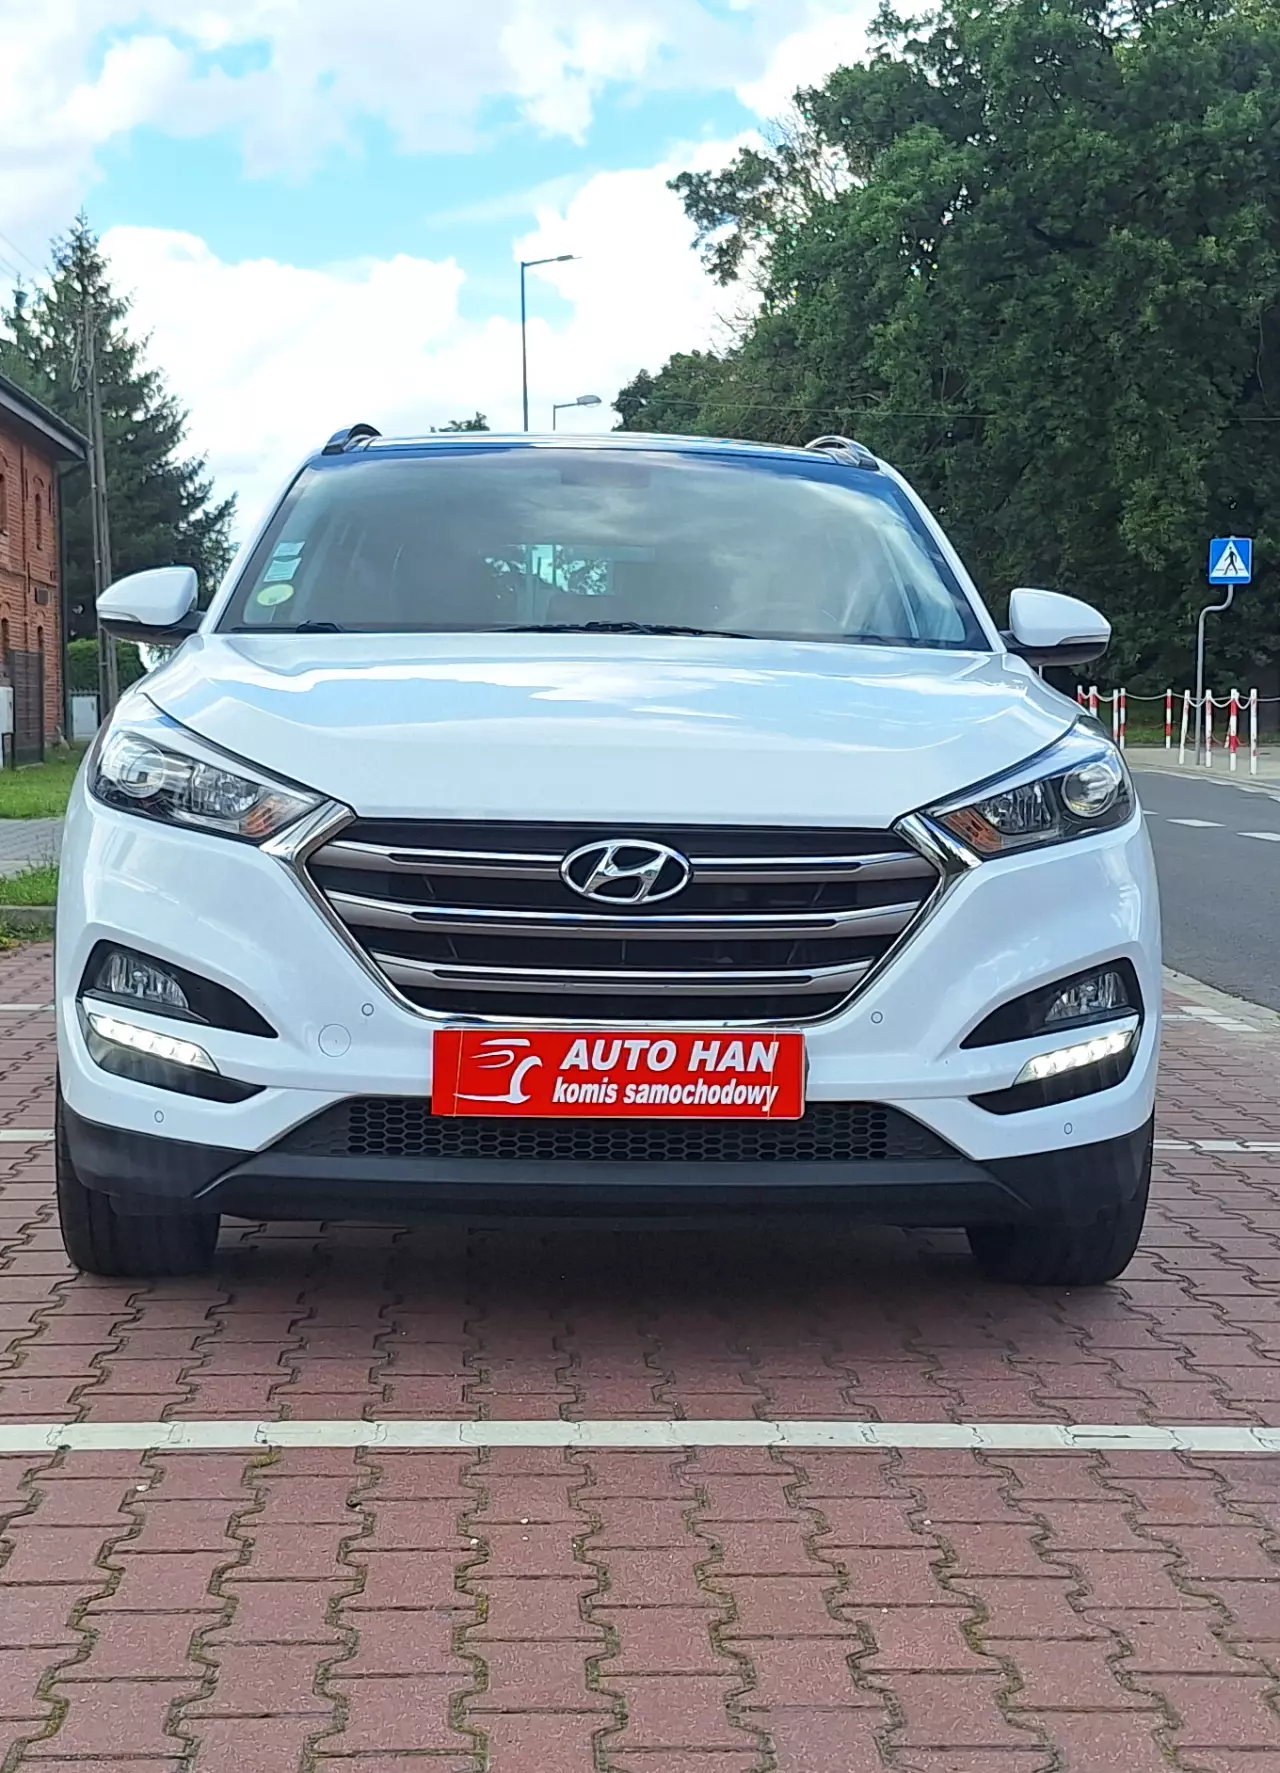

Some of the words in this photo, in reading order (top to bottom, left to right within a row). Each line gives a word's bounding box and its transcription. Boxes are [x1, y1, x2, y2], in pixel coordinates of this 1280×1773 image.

[559, 1039, 677, 1071] AUTO
[687, 1040, 779, 1073] HAN
[552, 1076, 618, 1104] komis
[623, 1078, 779, 1112] samochodowy
